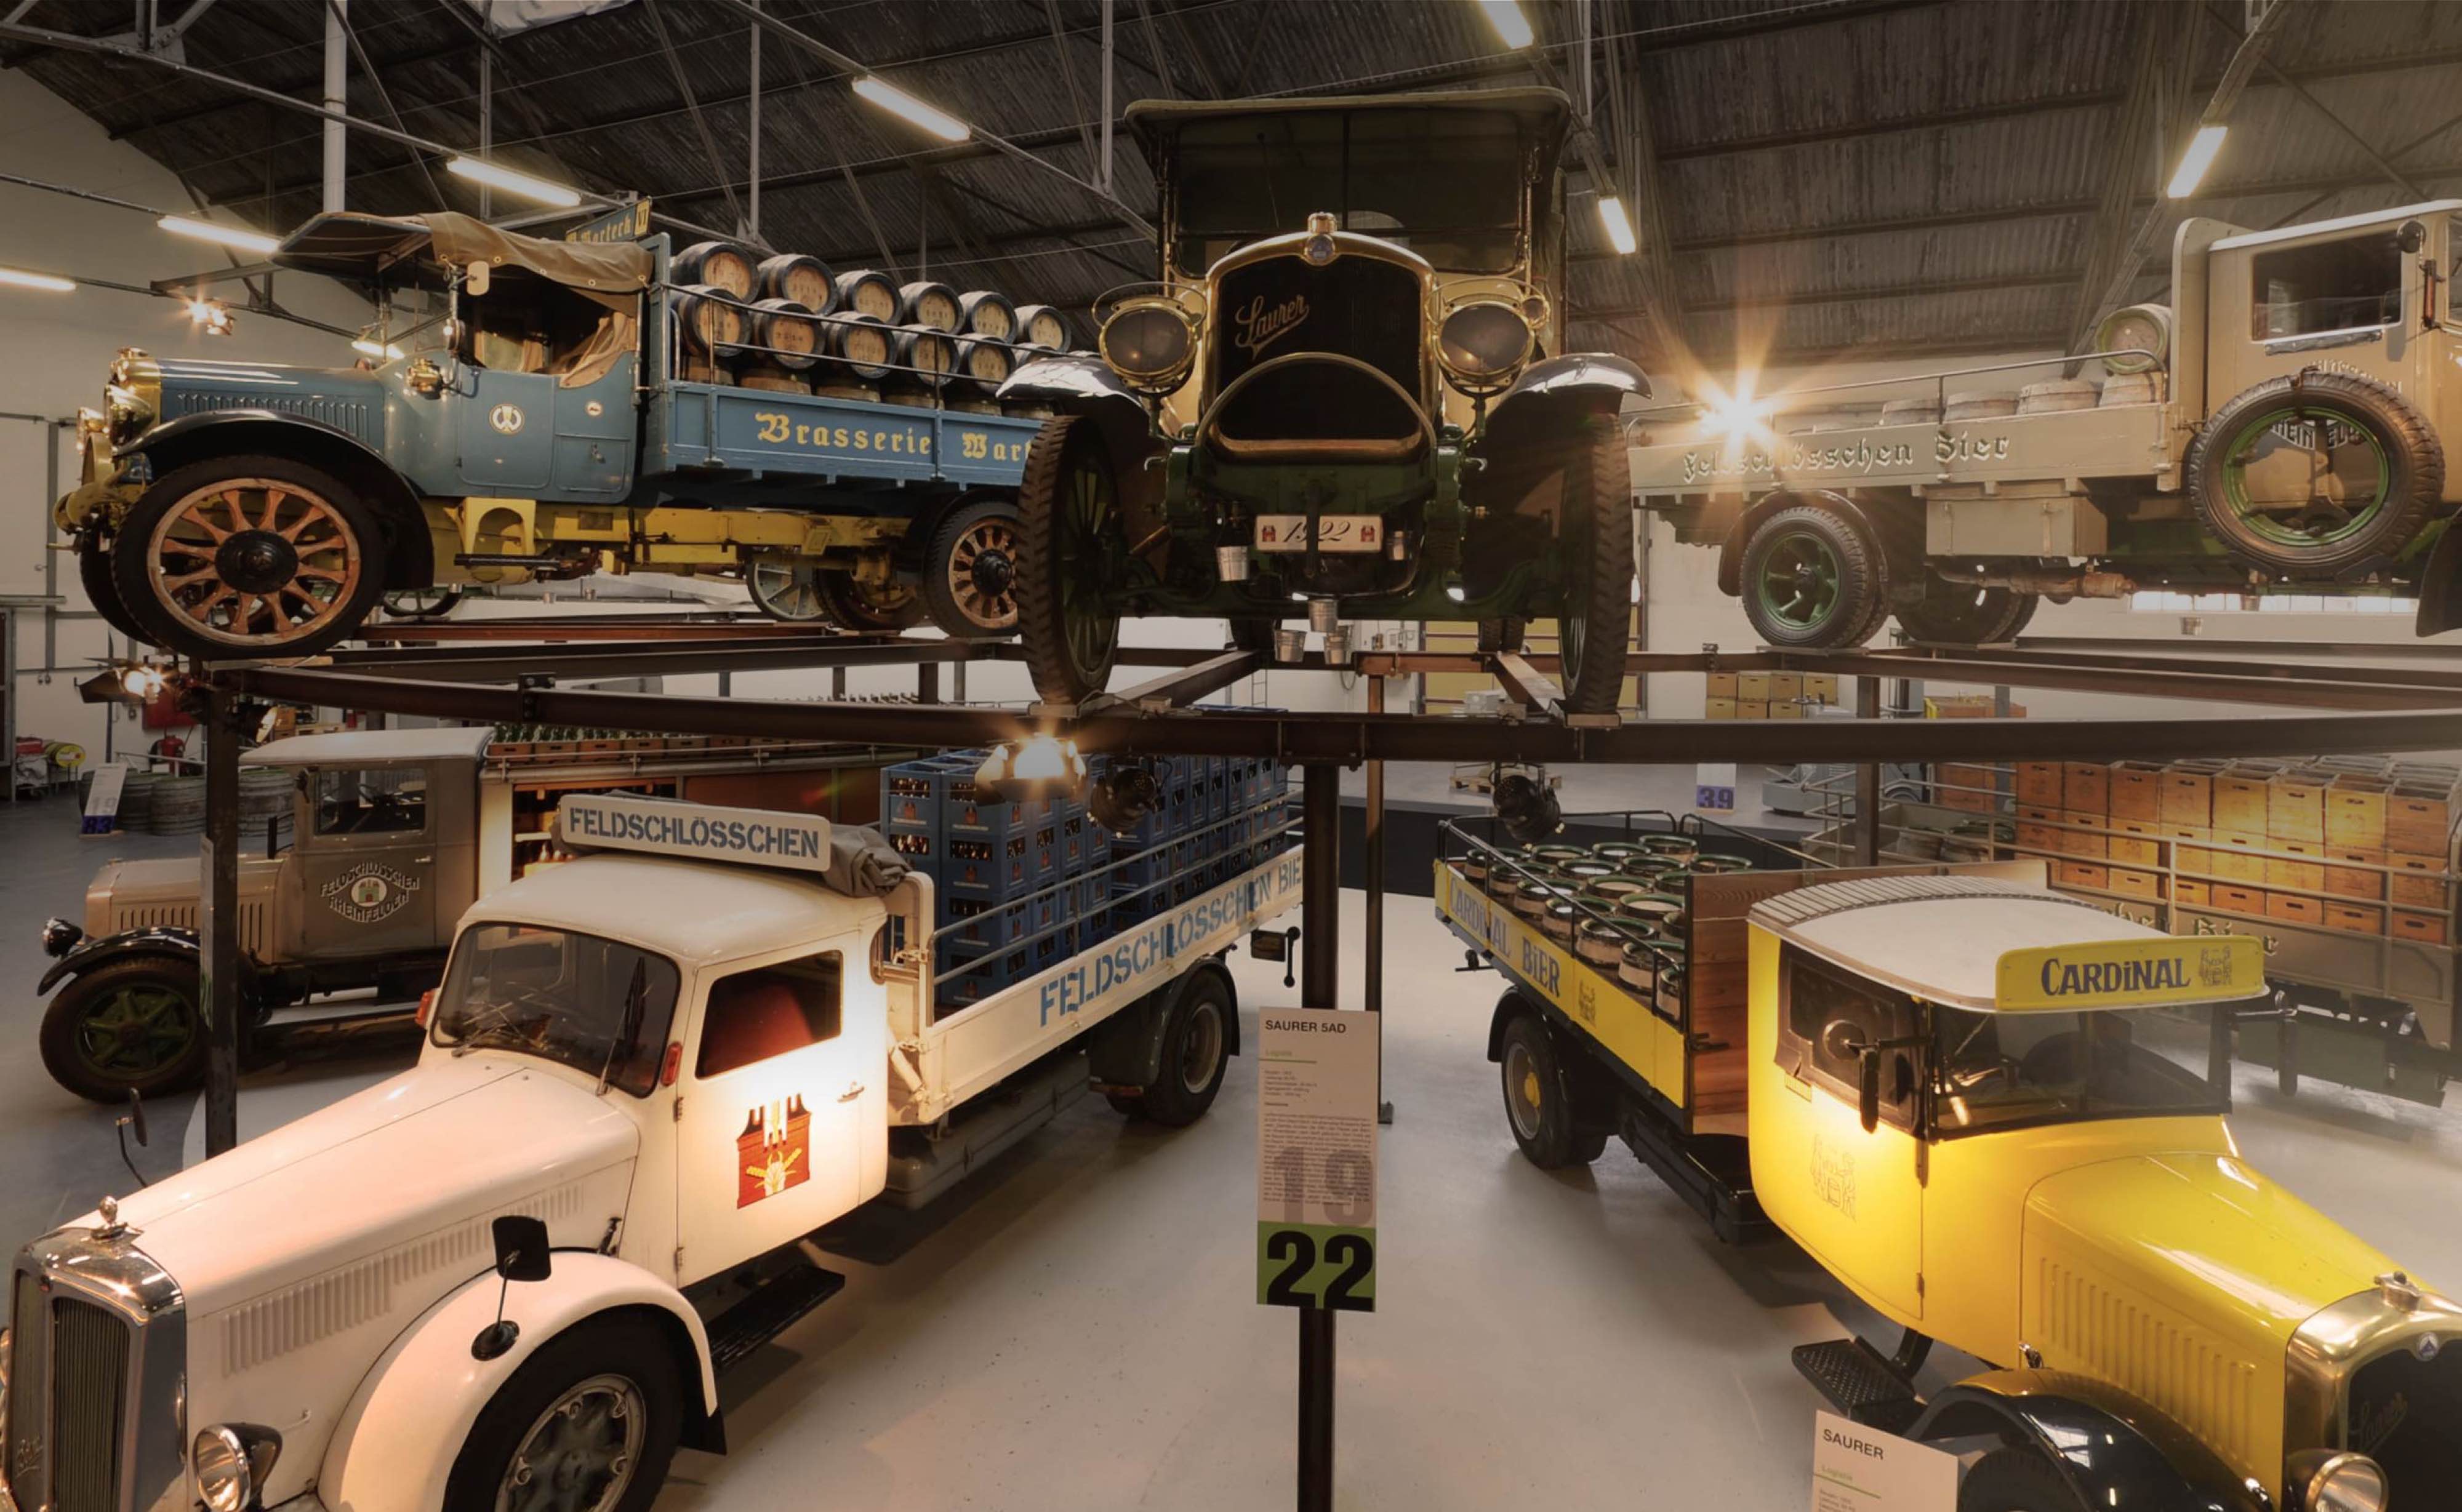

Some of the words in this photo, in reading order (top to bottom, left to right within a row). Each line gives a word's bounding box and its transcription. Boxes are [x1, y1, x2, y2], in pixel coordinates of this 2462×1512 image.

[1235, 295, 1310, 360] Saurer
[755, 413, 932, 454] Brasserie
[1935, 429, 2010, 463] Bier
[1698, 788, 1733, 809] 39
[570, 807, 819, 858] FELDSCHLÖSSCHEN
[1040, 871, 1272, 1027] FELDSCHLÖSSCHEN
[1278, 856, 1302, 893] BIE
[1265, 1020, 1318, 1033] SAURER
[1321, 1023, 1347, 1034] 5AD
[1266, 1230, 1374, 1313] 22
[1823, 1428, 1884, 1460] SAURER
